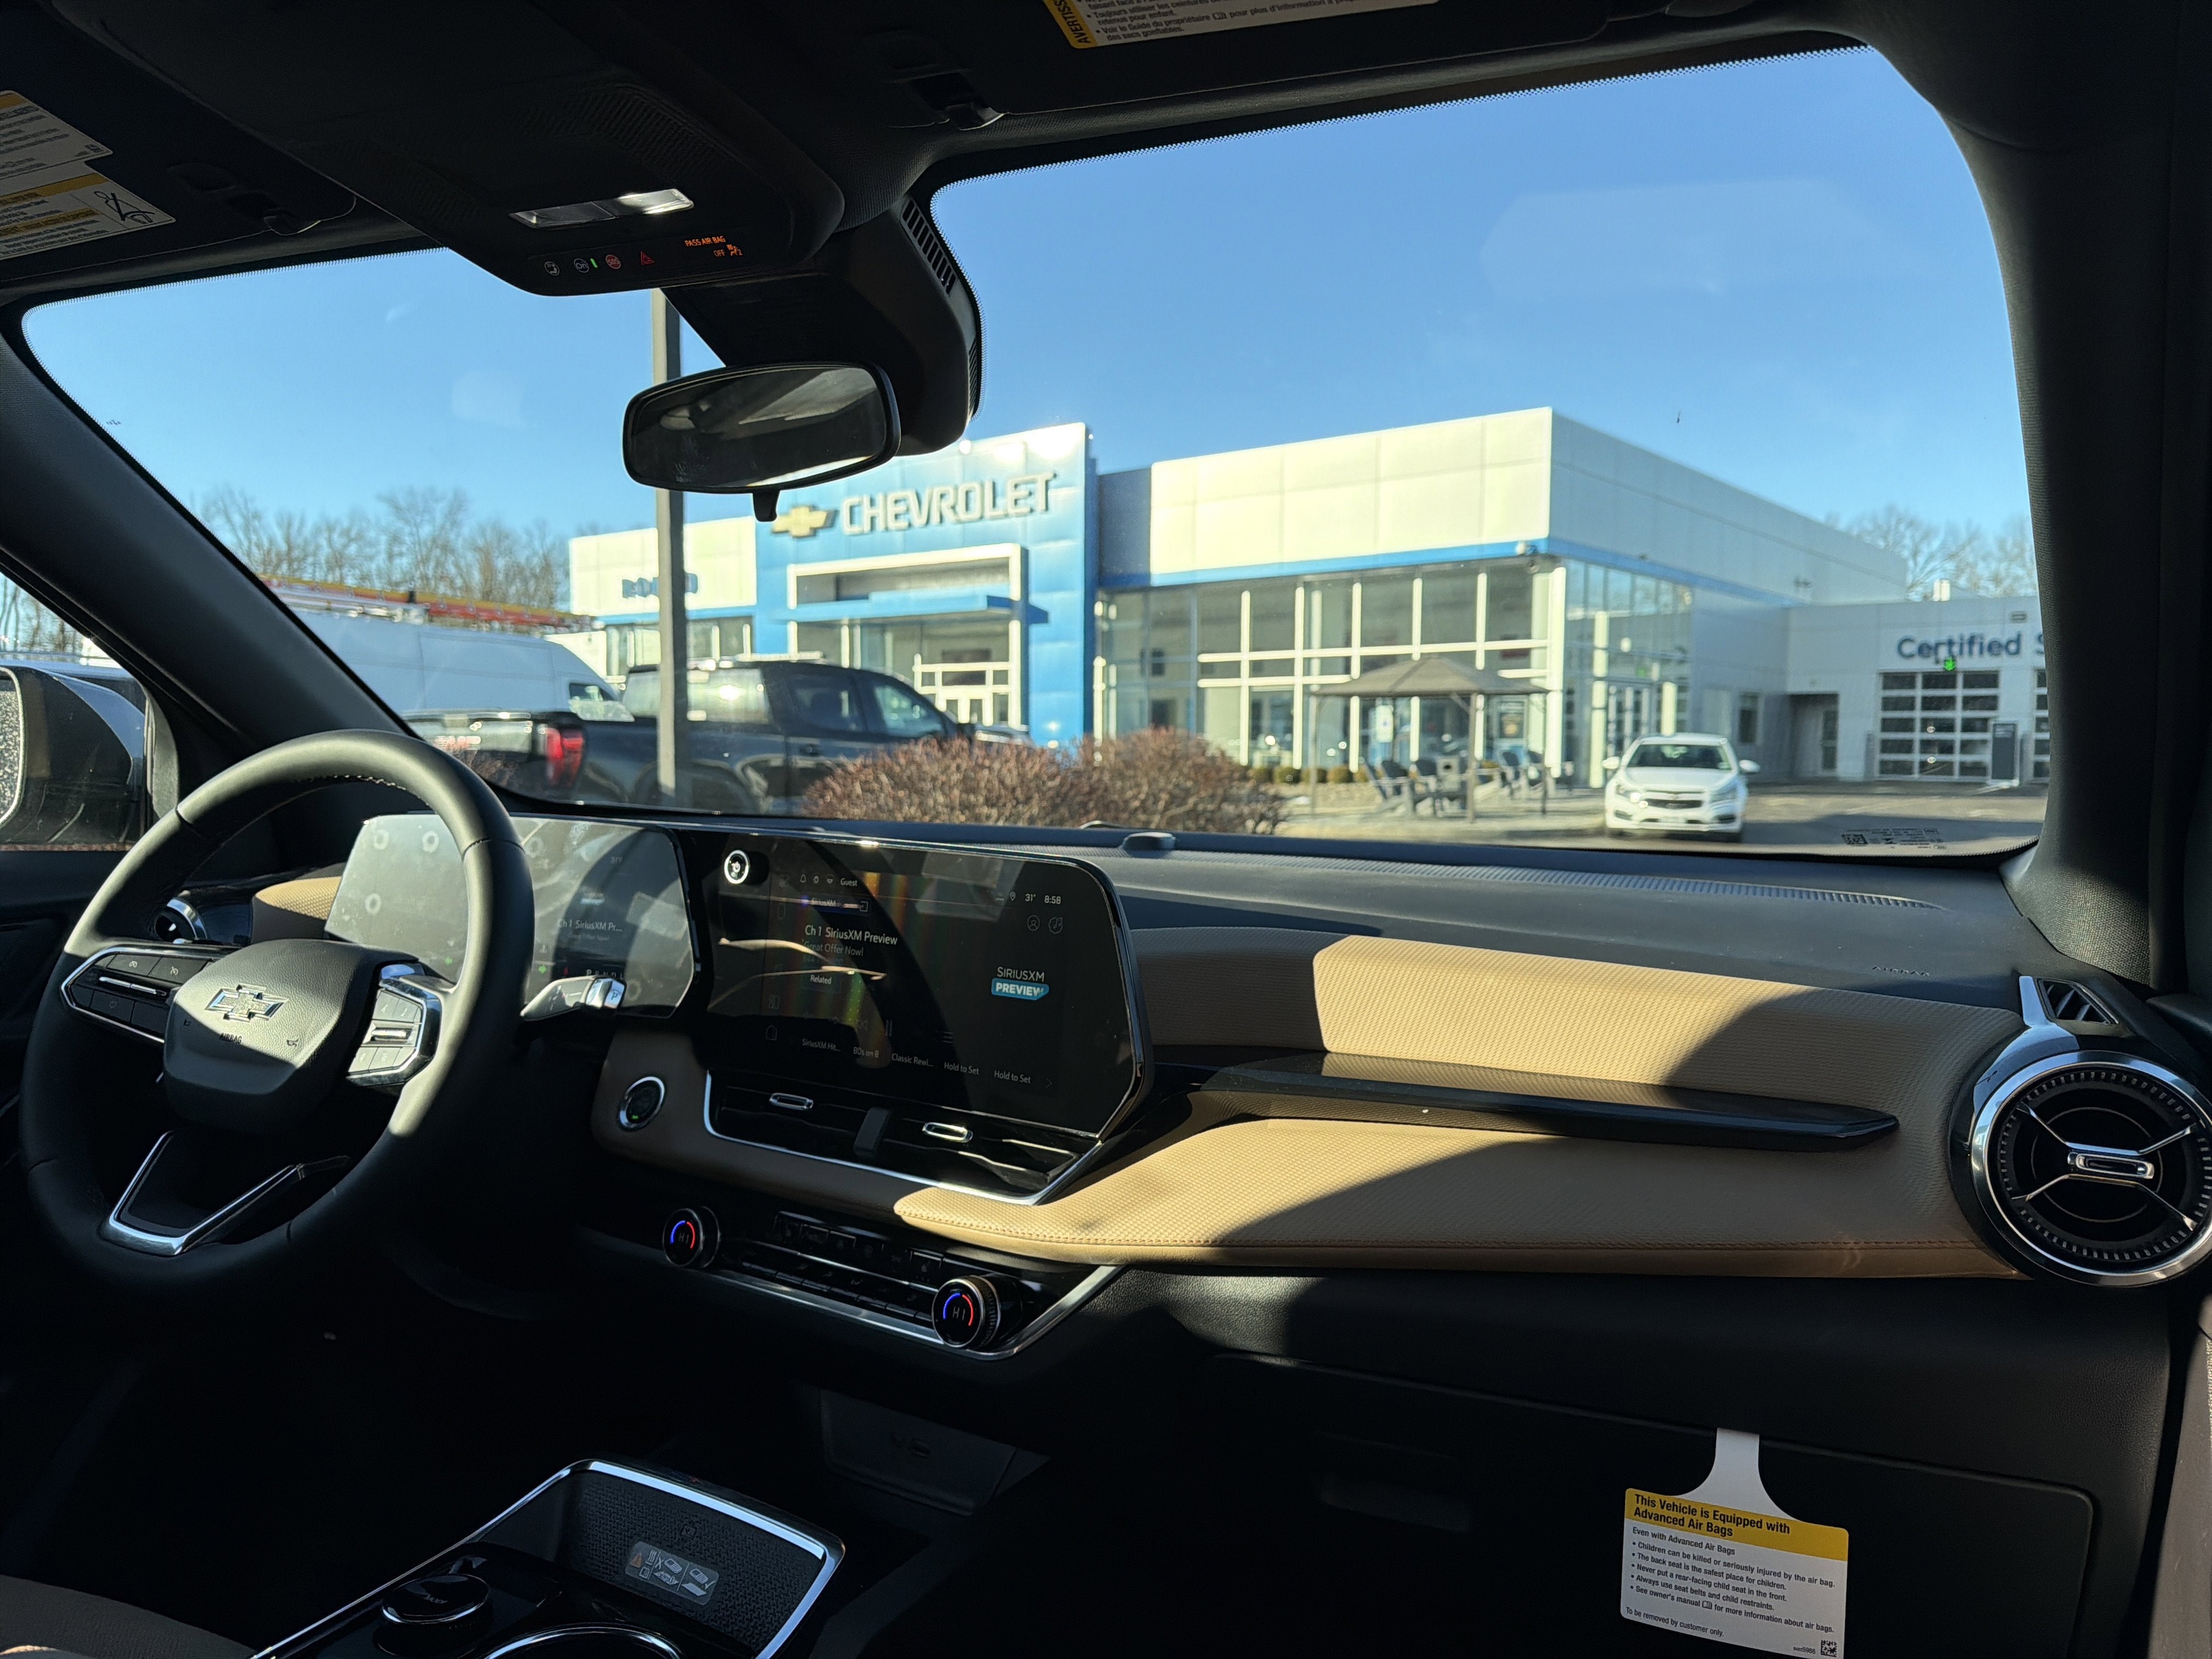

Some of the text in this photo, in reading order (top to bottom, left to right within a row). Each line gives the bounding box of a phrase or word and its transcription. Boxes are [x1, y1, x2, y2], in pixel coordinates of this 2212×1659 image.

[1128, 22, 1150, 31] Guide
[1164, 15, 1211, 27] propriétaire
[1229, 9, 1248, 18] pour
[1250, 7, 1268, 16] plus
[702, 237, 713, 245] AIR
[840, 470, 1057, 536] CHEVROLET
[1897, 632, 2022, 659] Certified
[840, 877, 858, 887] Guest
[1044, 895, 1062, 905] 8:58
[575, 920, 606, 931] SiriusXM
[805, 924, 898, 946] Ch 1 SiriusXM Preview
[825, 944, 843, 954] Offer
[845, 945, 864, 956] Now!
[810, 974, 832, 984] Related
[997, 966, 1045, 982] SIRIUSXM
[996, 983, 1045, 996] PREVIEW
[219, 1032, 242, 1045] AIRBAG
[802, 1038, 826, 1049] SiriusXM
[853, 1047, 865, 1056] 80s
[874, 1050, 879, 1058] 8
[891, 1053, 912, 1064] Classic
[944, 1062, 979, 1075] Hold to Set
[994, 1070, 1031, 1084] Hold to Set
[679, 1232, 690, 1244] HI
[952, 1306, 966, 1321] HI
[1635, 1493, 1790, 1534] This Vehicle is Equipped with
[1634, 1506, 1733, 1537] Advanced Air Bags
[1633, 1526, 1735, 1555] Even with Advanced Air Bags
[1637, 1552, 1649, 1561] The
[1651, 1555, 1667, 1566] back
[1668, 1561, 1683, 1569] seat
[1691, 1565, 1703, 1573] the
[1703, 1568, 1724, 1578] safest
[1725, 1573, 1744, 1582] place
[1746, 1576, 1756, 1584] for
[1757, 1579, 1787, 1590] children.
[1638, 1542, 1666, 1554] Children
[1682, 1551, 1691, 1560] be
[1692, 1553, 1712, 1564] killed
[1723, 1561, 1754, 1574] seriously
[1757, 1566, 1781, 1578] injured
[1784, 1572, 1792, 1581] by
[1795, 1574, 1806, 1582] the
[1820, 1578, 1835, 1588] bag.
[1637, 1563, 1656, 1573] Never
[1675, 1573, 1712, 1588] rear-facing
[1713, 1582, 1730, 1590] child
[1731, 1585, 1746, 1594] seat
[1756, 1590, 1767, 1598] the
[1769, 1592, 1787, 1601] front.
[1636, 1575, 1774, 1611] Always use seat belts and child restraints.
[1636, 1585, 1648, 1594] See
[1649, 1589, 1674, 1601] owner's
[1676, 1596, 1700, 1607] manual
[1714, 1604, 1724, 1612] for
[1725, 1607, 1742, 1616] more
[1744, 1610, 1782, 1624] information
[1784, 1618, 1803, 1628] about
[1816, 1623, 1834, 1633] bags.
[1626, 1606, 1724, 1638] To be removed by customer only.
